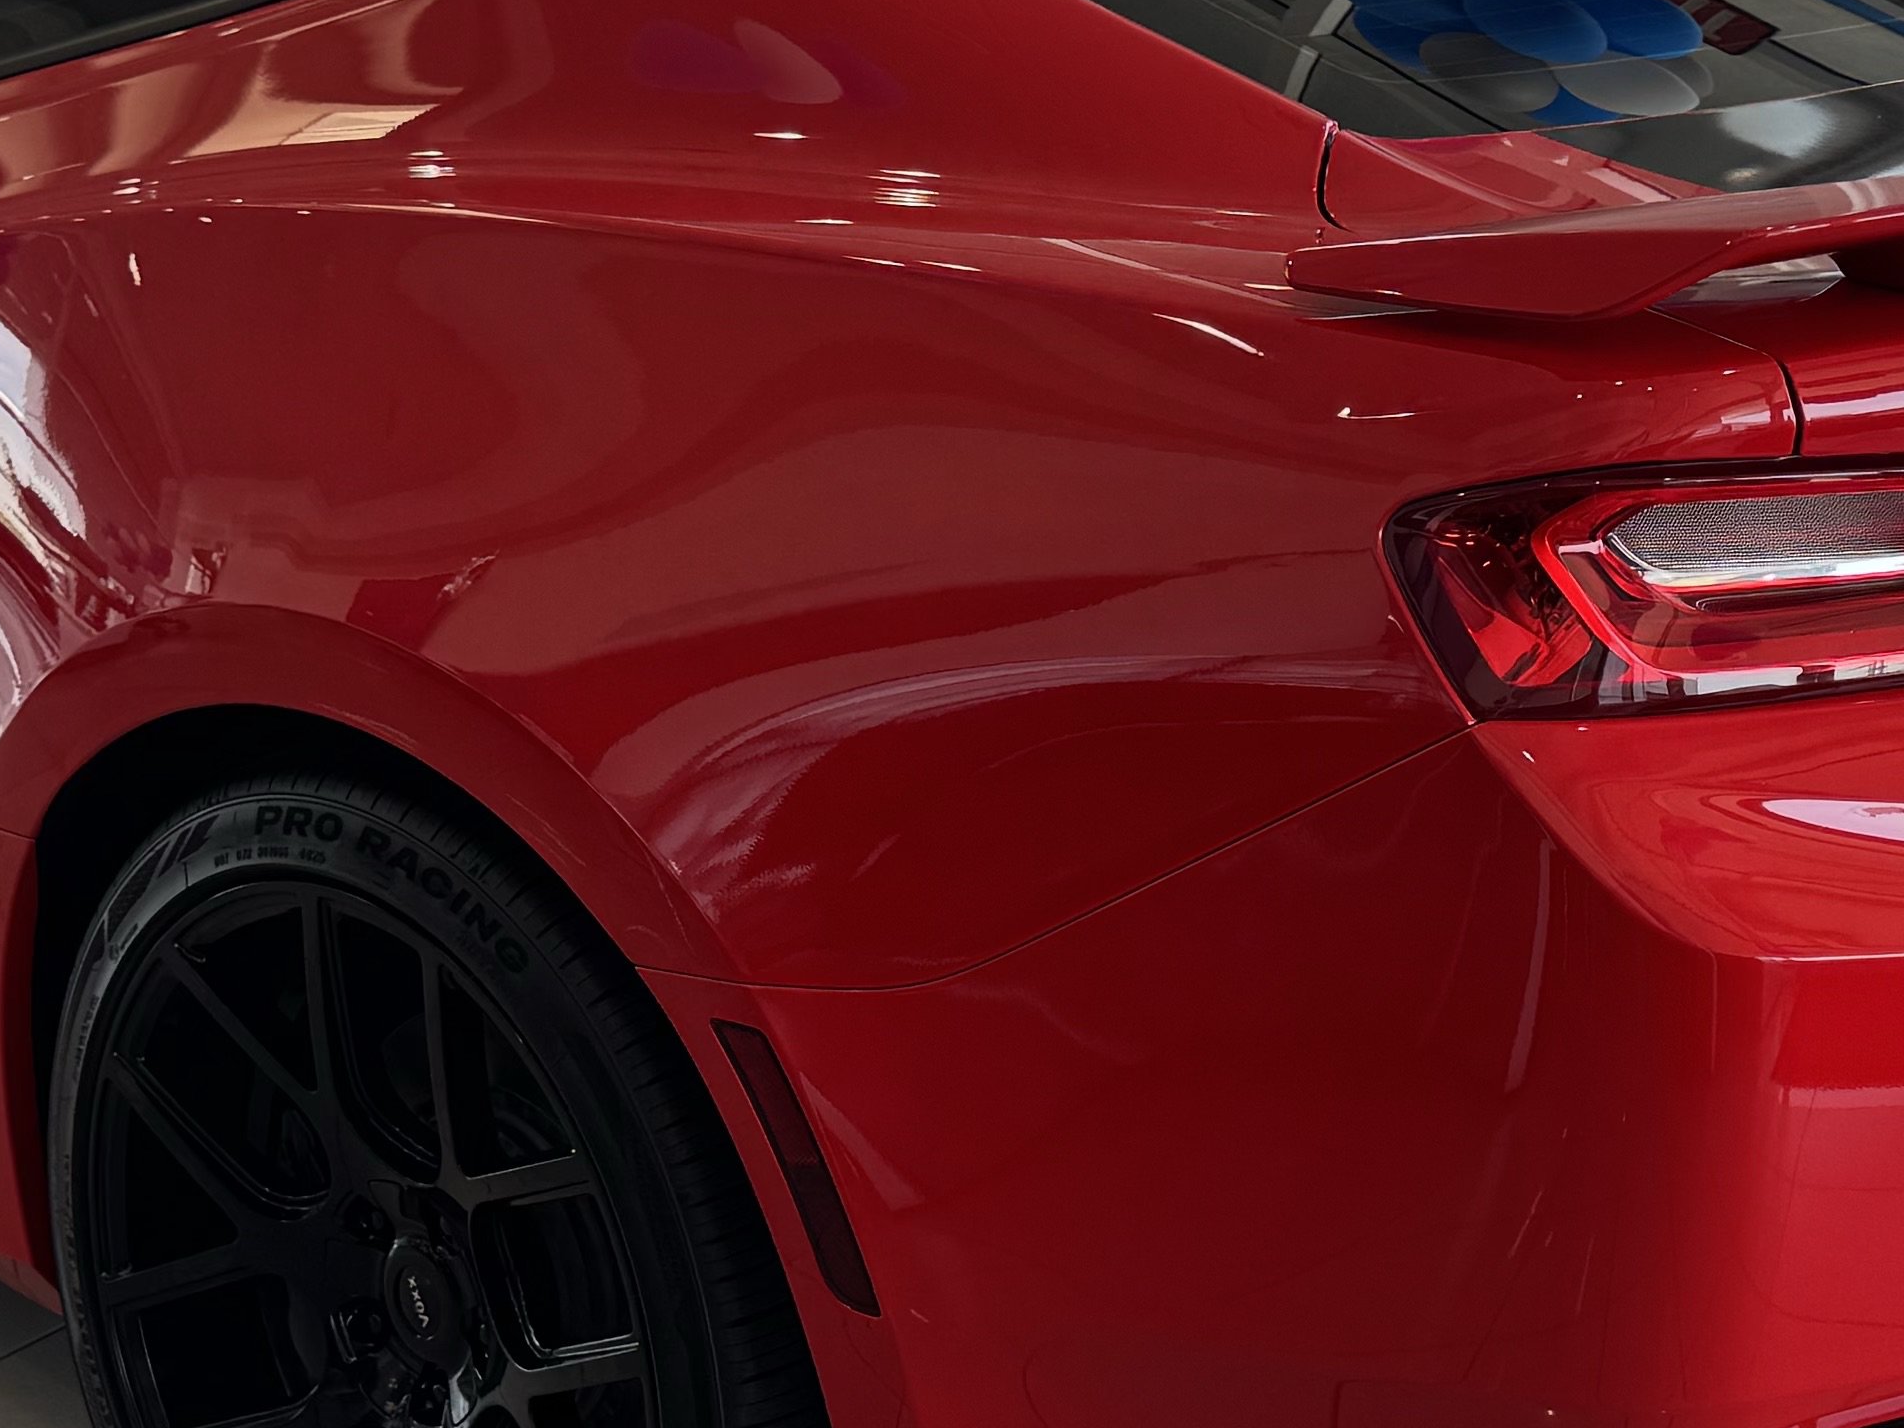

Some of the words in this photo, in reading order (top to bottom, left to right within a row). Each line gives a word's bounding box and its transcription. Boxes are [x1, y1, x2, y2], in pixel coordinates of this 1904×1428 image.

[255, 805, 344, 842] PRO
[356, 826, 529, 973] RACING
[408, 1275, 430, 1329] VOXX
